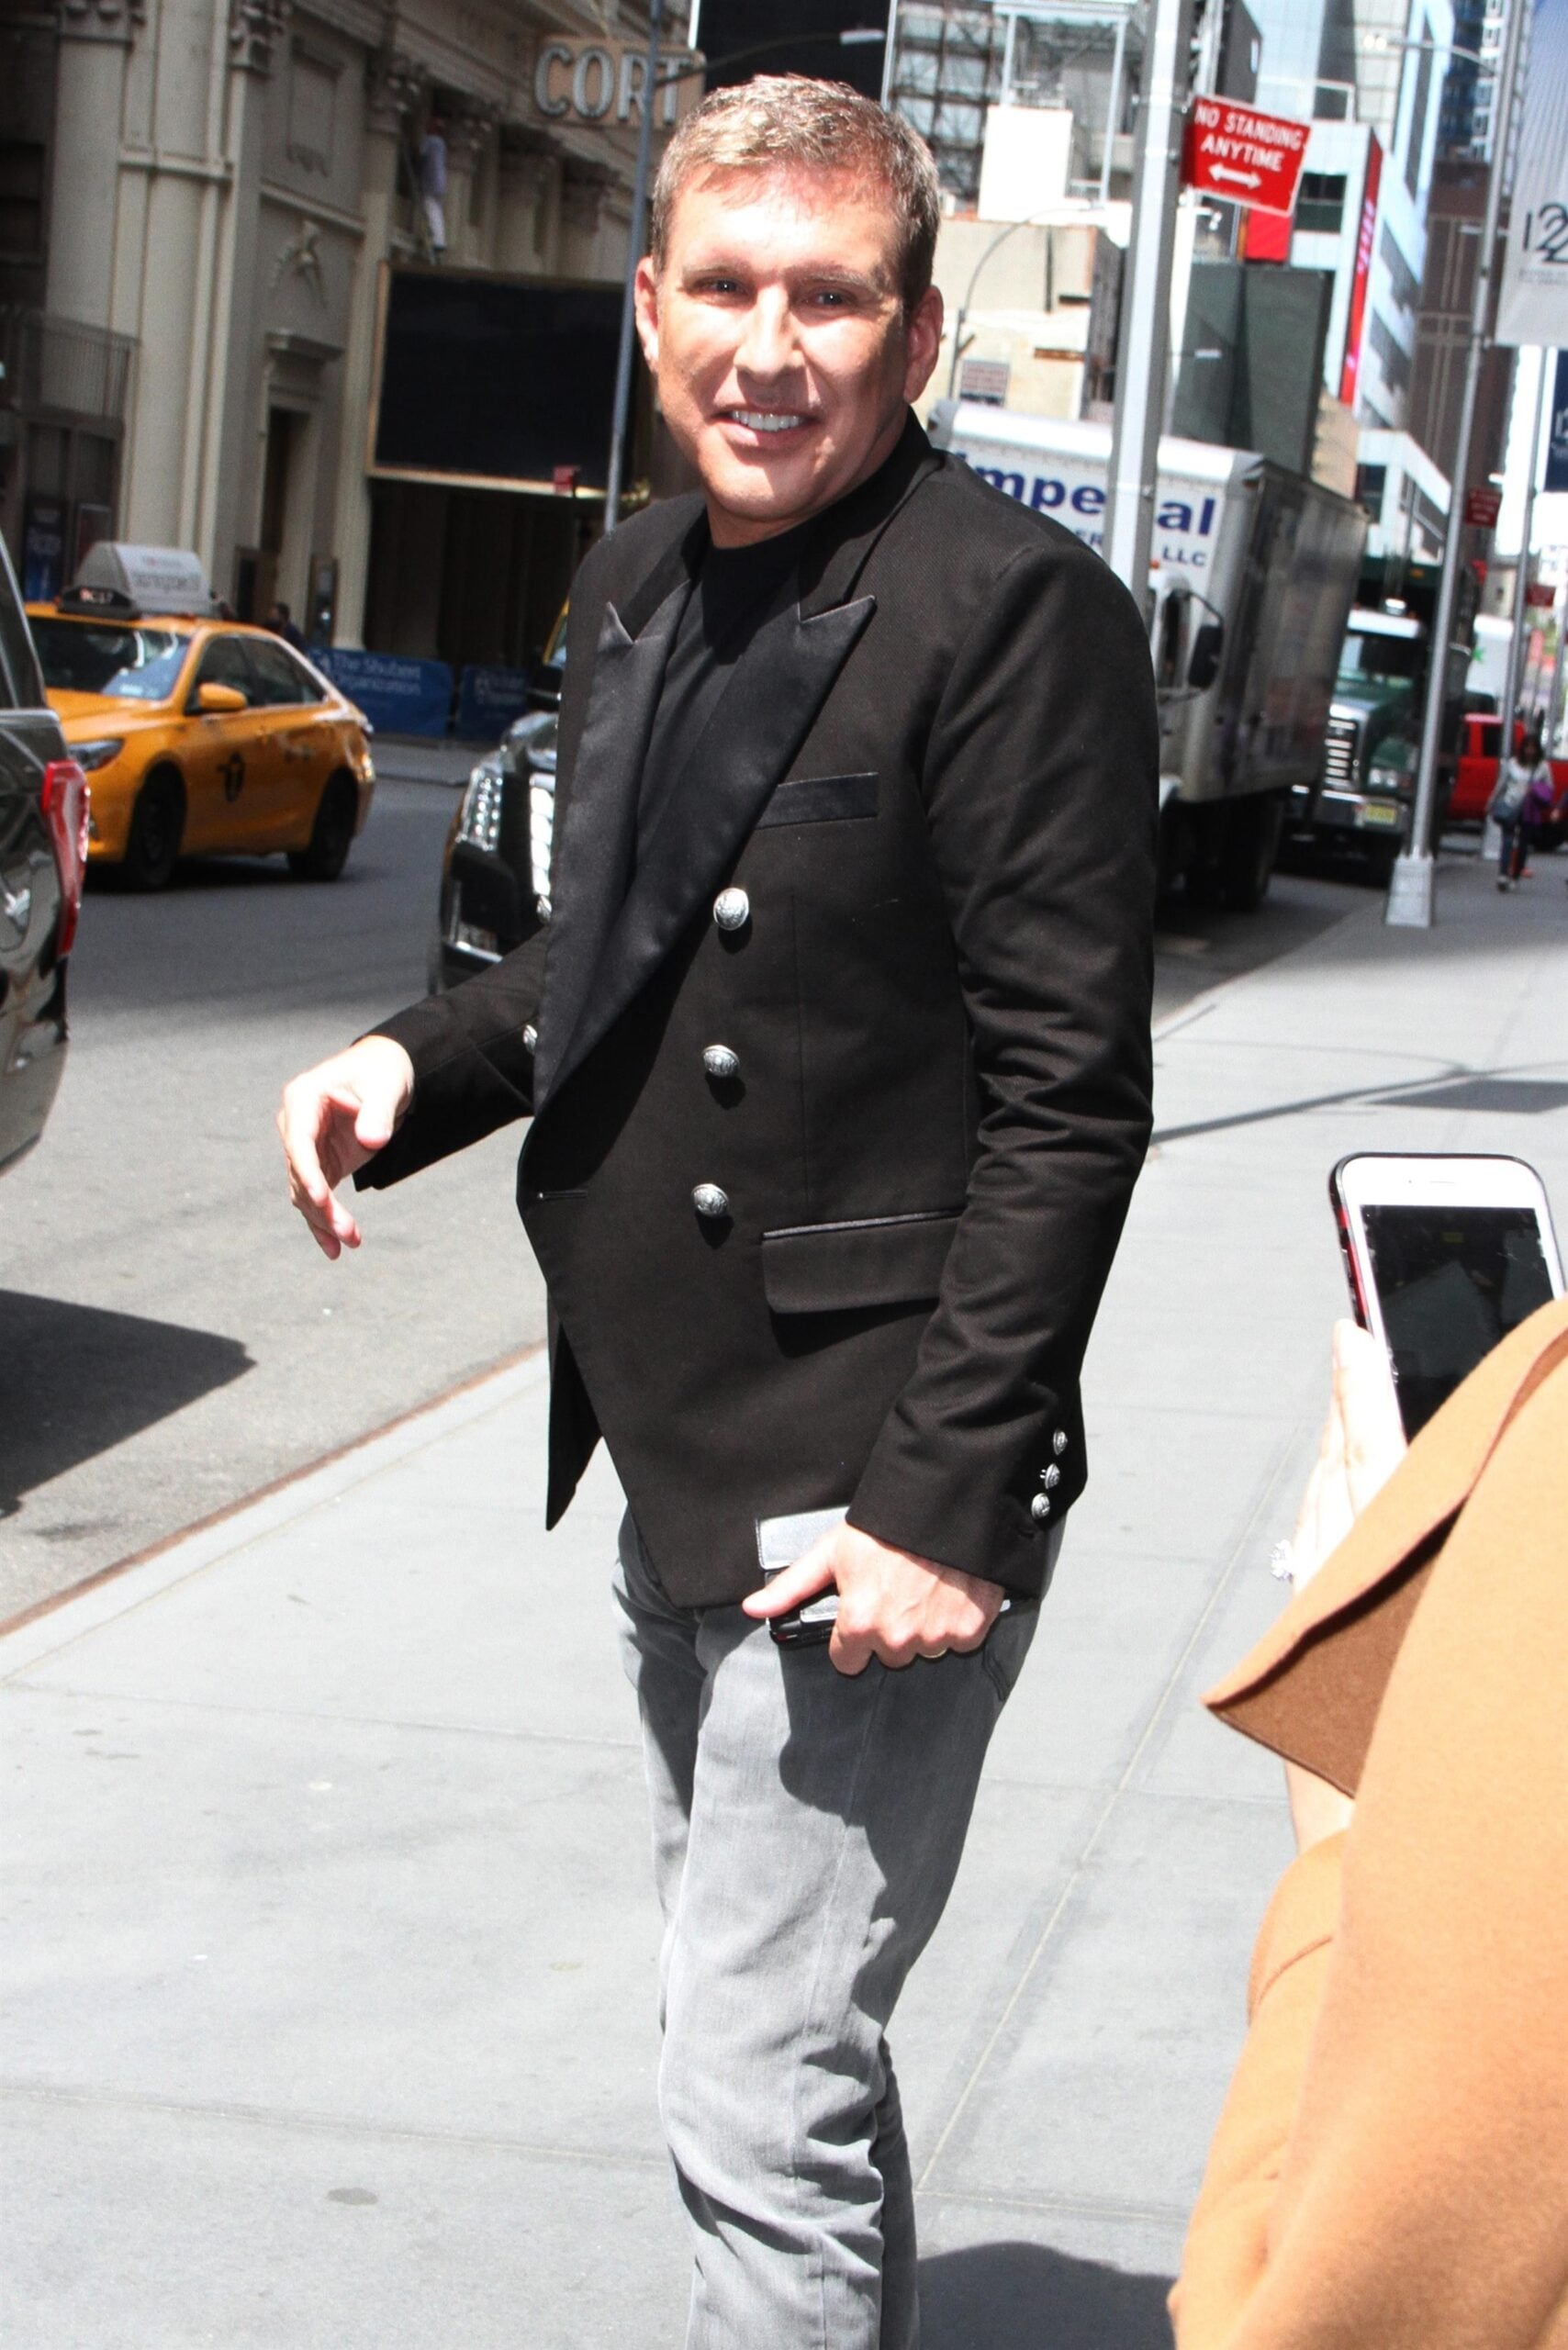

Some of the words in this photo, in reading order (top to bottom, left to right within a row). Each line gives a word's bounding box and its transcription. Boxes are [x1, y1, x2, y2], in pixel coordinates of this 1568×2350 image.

[534, 46, 691, 124] CORT
[1195, 105, 1220, 129] NO
[1224, 111, 1303, 151] STANDING
[1201, 133, 1284, 173] ANYTIME
[1162, 546, 1206, 566] LLC
